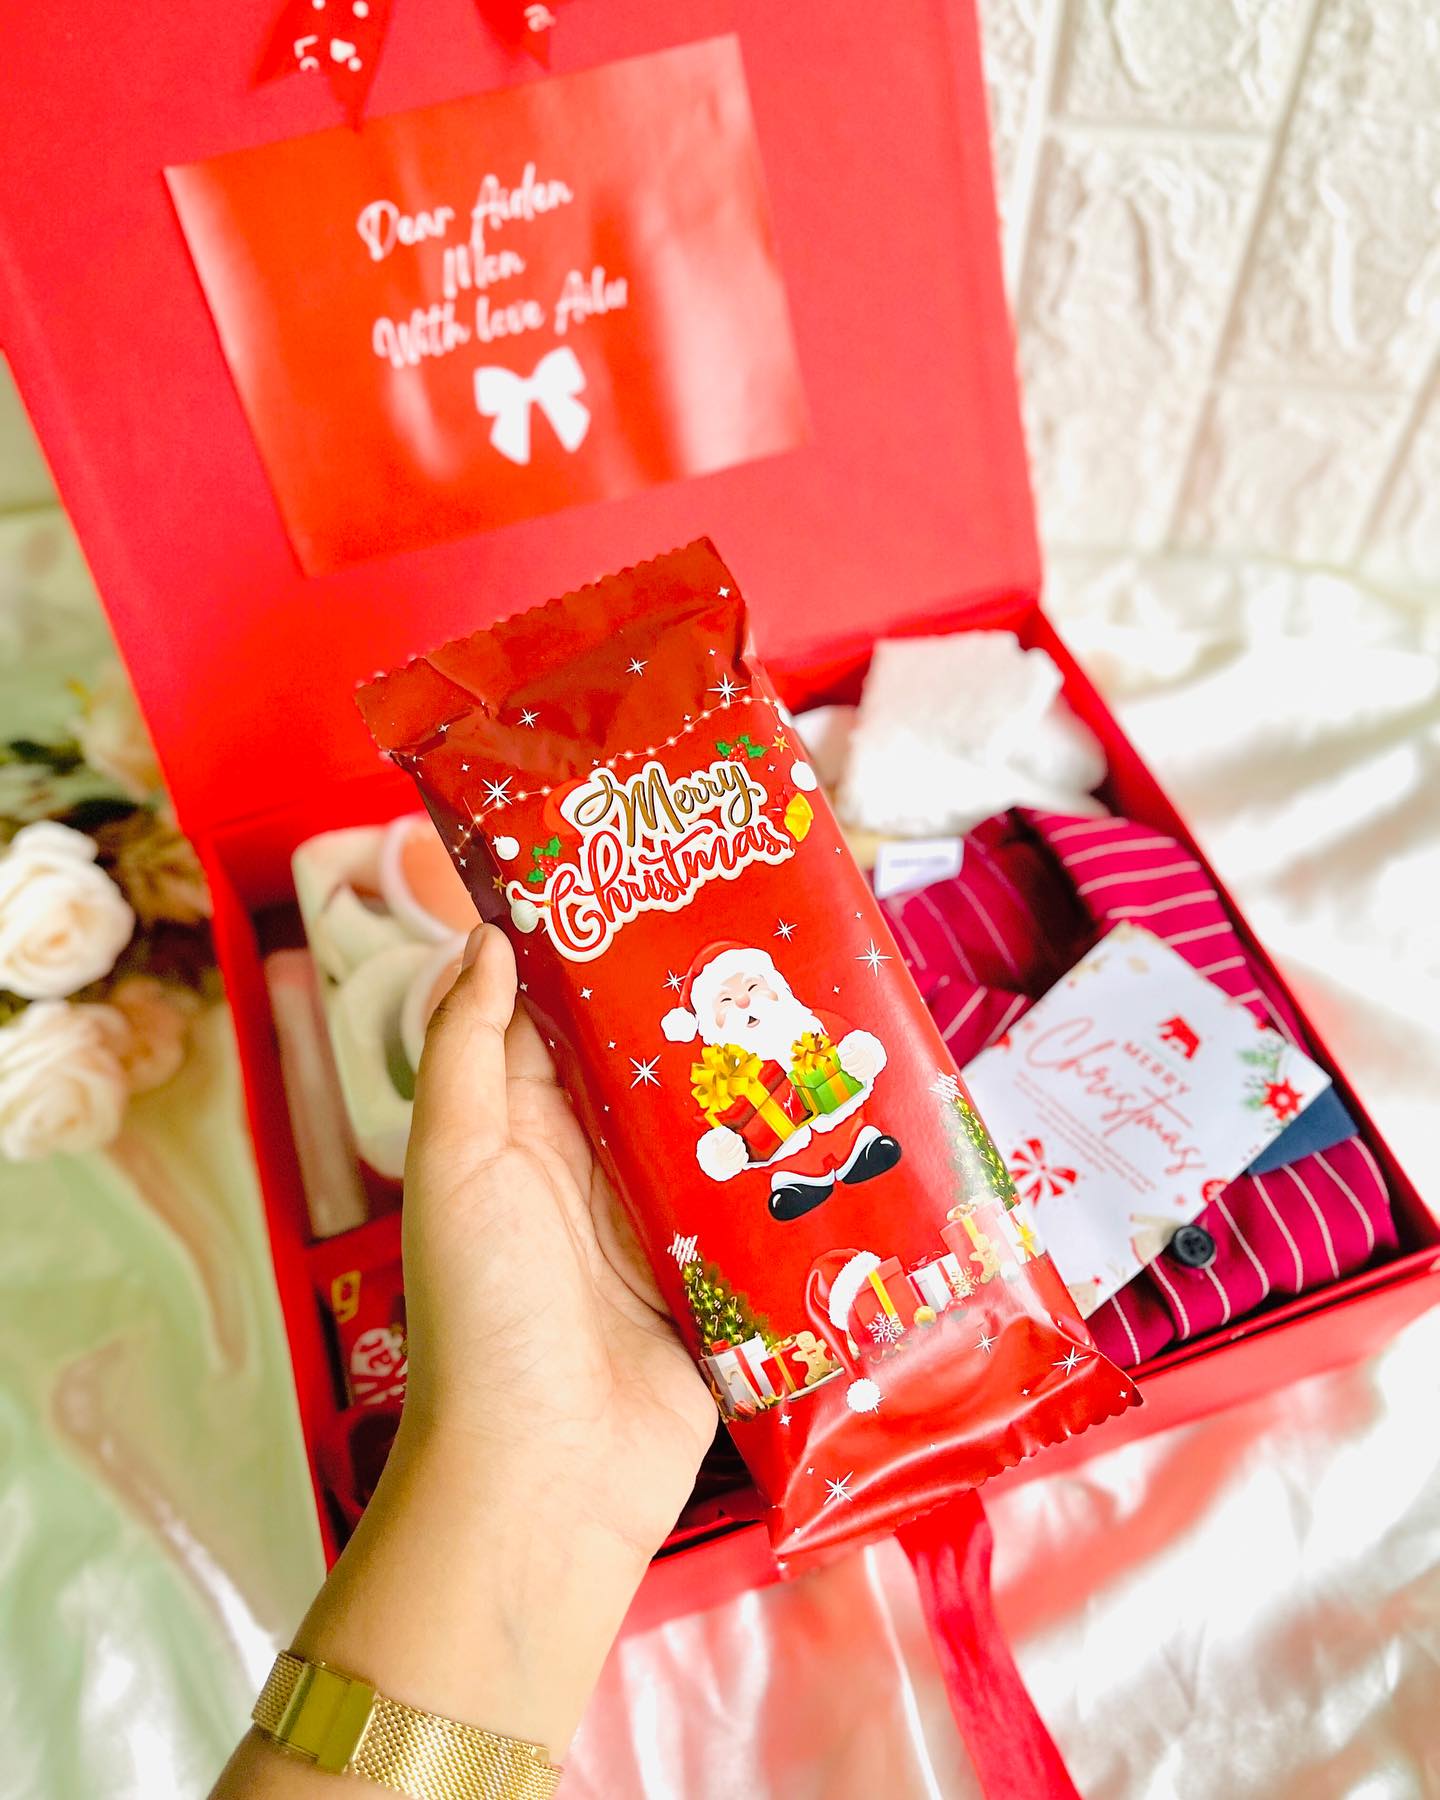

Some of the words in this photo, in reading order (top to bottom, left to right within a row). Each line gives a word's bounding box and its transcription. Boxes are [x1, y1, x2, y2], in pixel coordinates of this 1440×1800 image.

[357, 199, 455, 261] Dear
[470, 161, 573, 239] Aiden
[371, 302, 470, 368] With
[476, 295, 546, 342] love
[573, 763, 761, 848] Merry
[511, 821, 785, 953] Christmas
[1025, 1016, 1207, 1175] Christmas
[1122, 1040, 1191, 1095] MERRY
